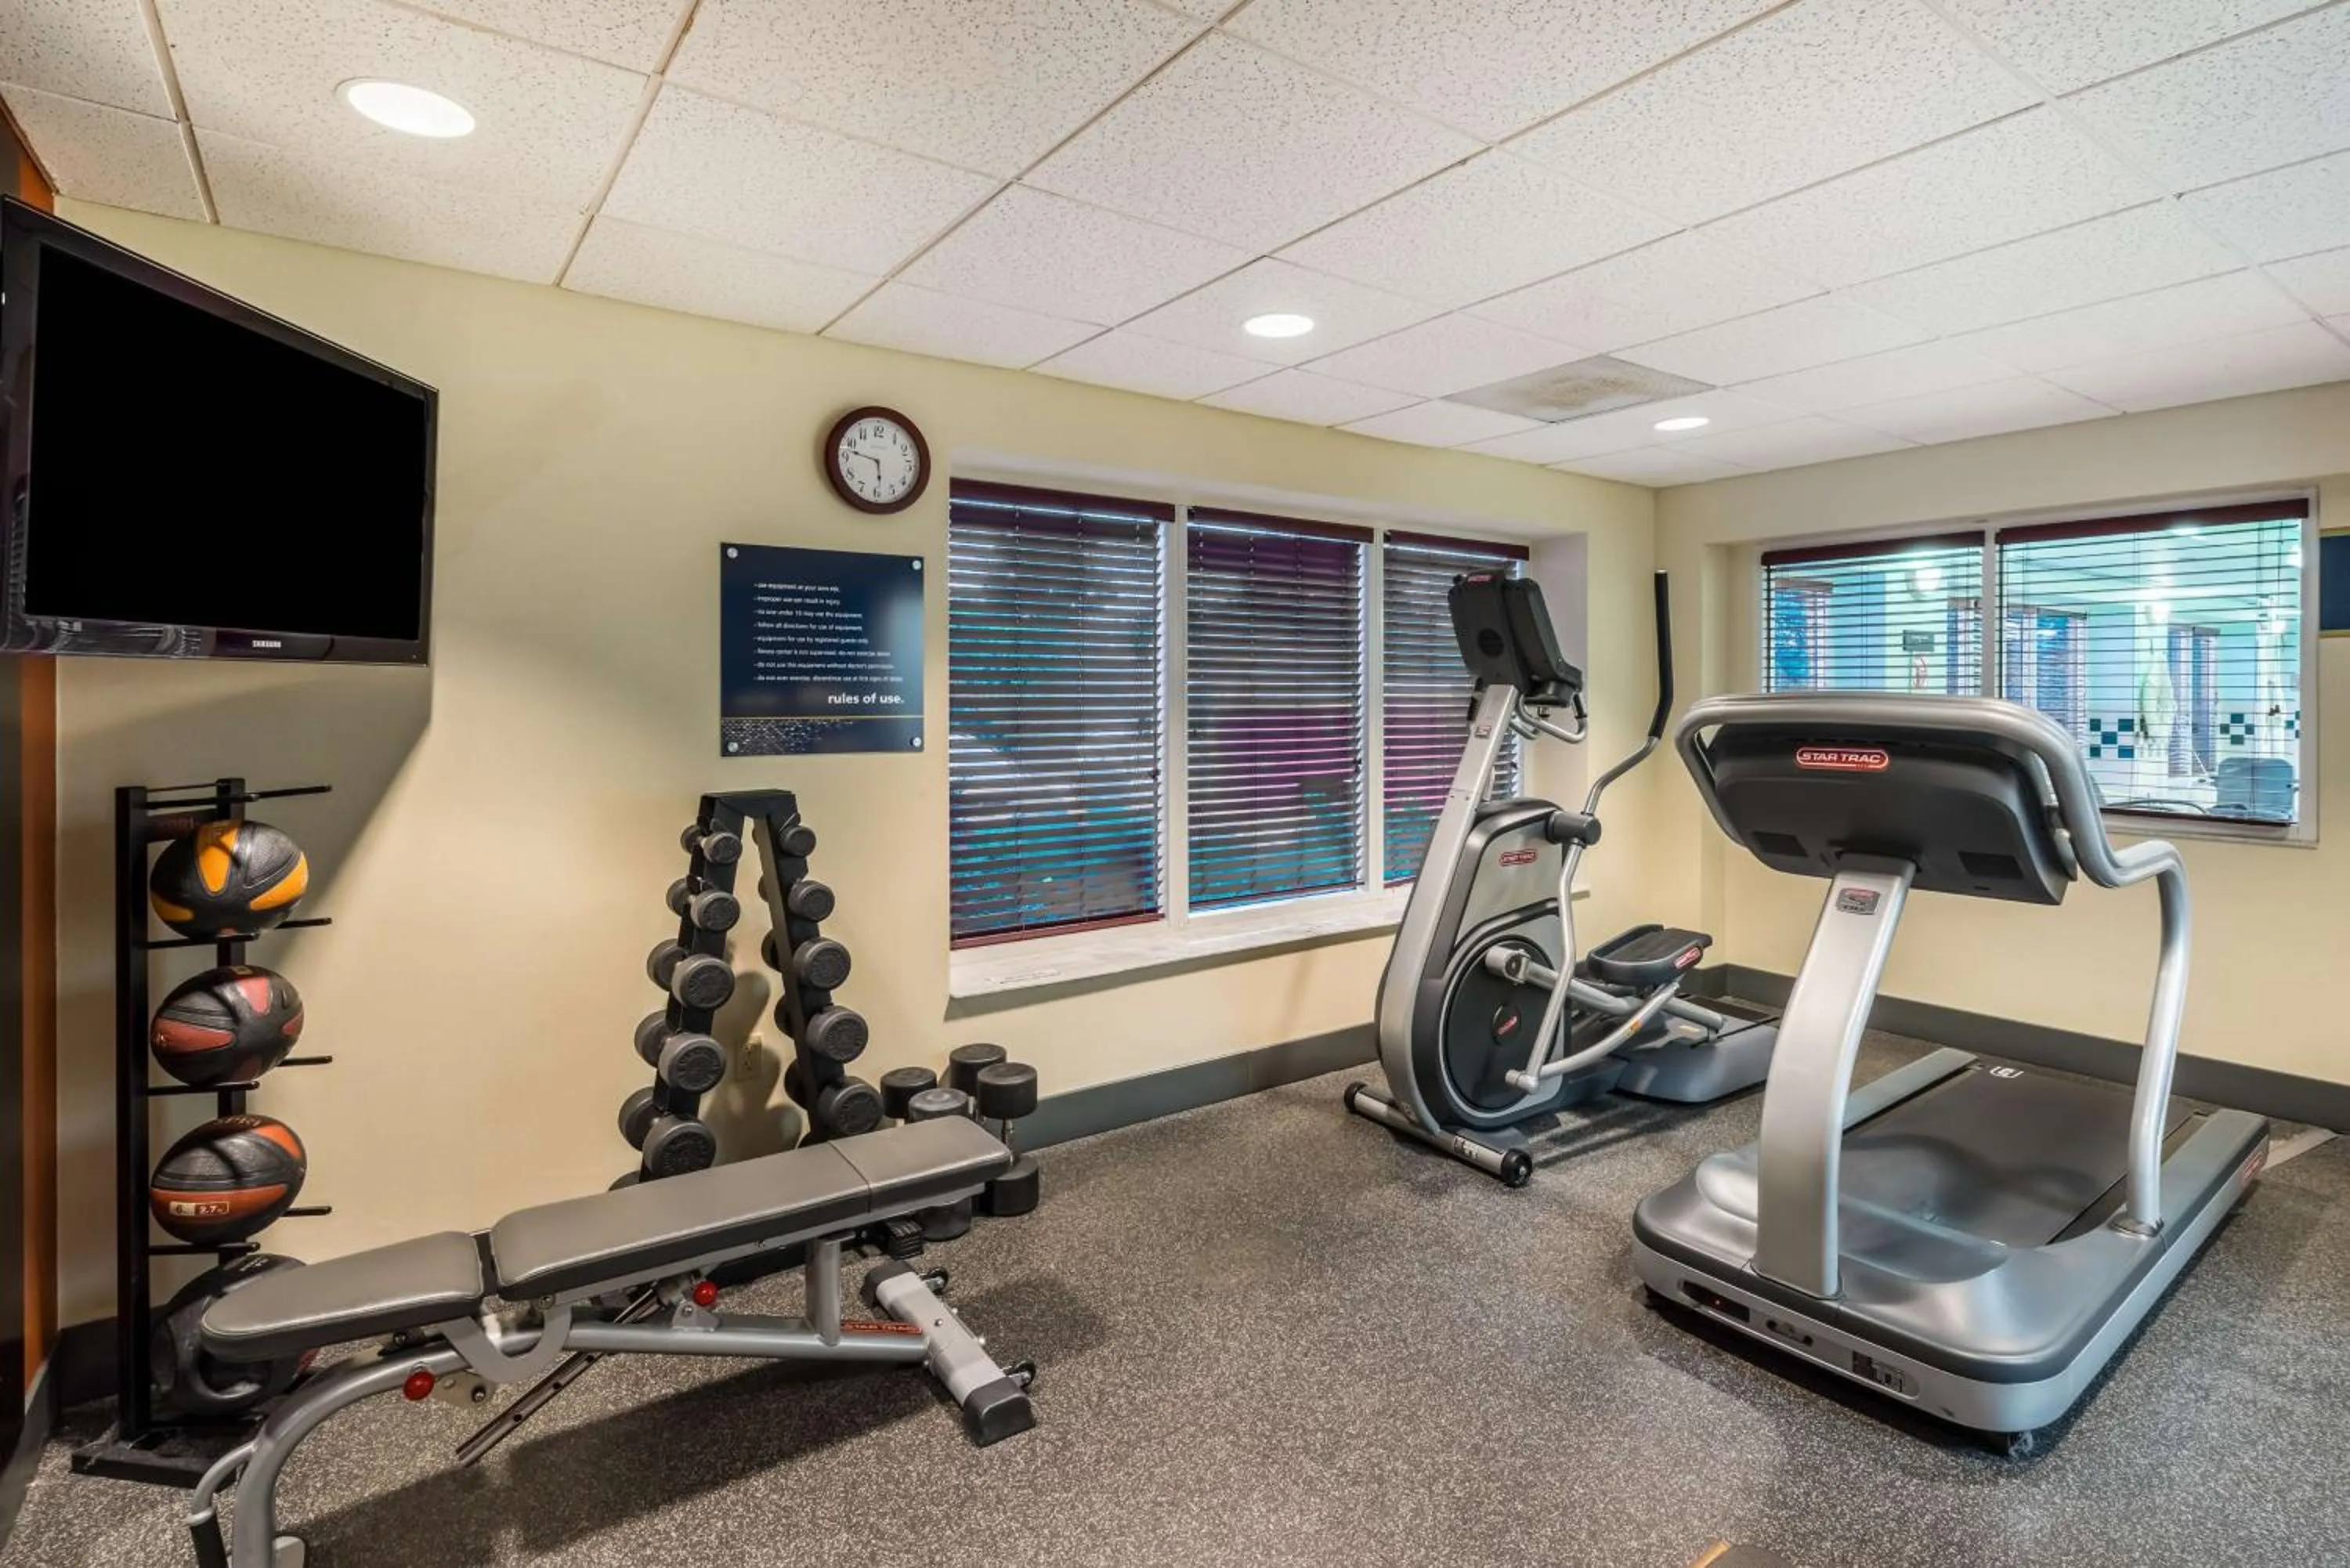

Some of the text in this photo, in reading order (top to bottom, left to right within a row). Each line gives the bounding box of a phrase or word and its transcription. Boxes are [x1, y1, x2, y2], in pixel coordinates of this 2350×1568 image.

[859, 427, 867, 440] 11
[873, 425, 884, 439] 12
[828, 692, 904, 704] rules of use.
[1802, 752, 1882, 764] STAR TRAC
